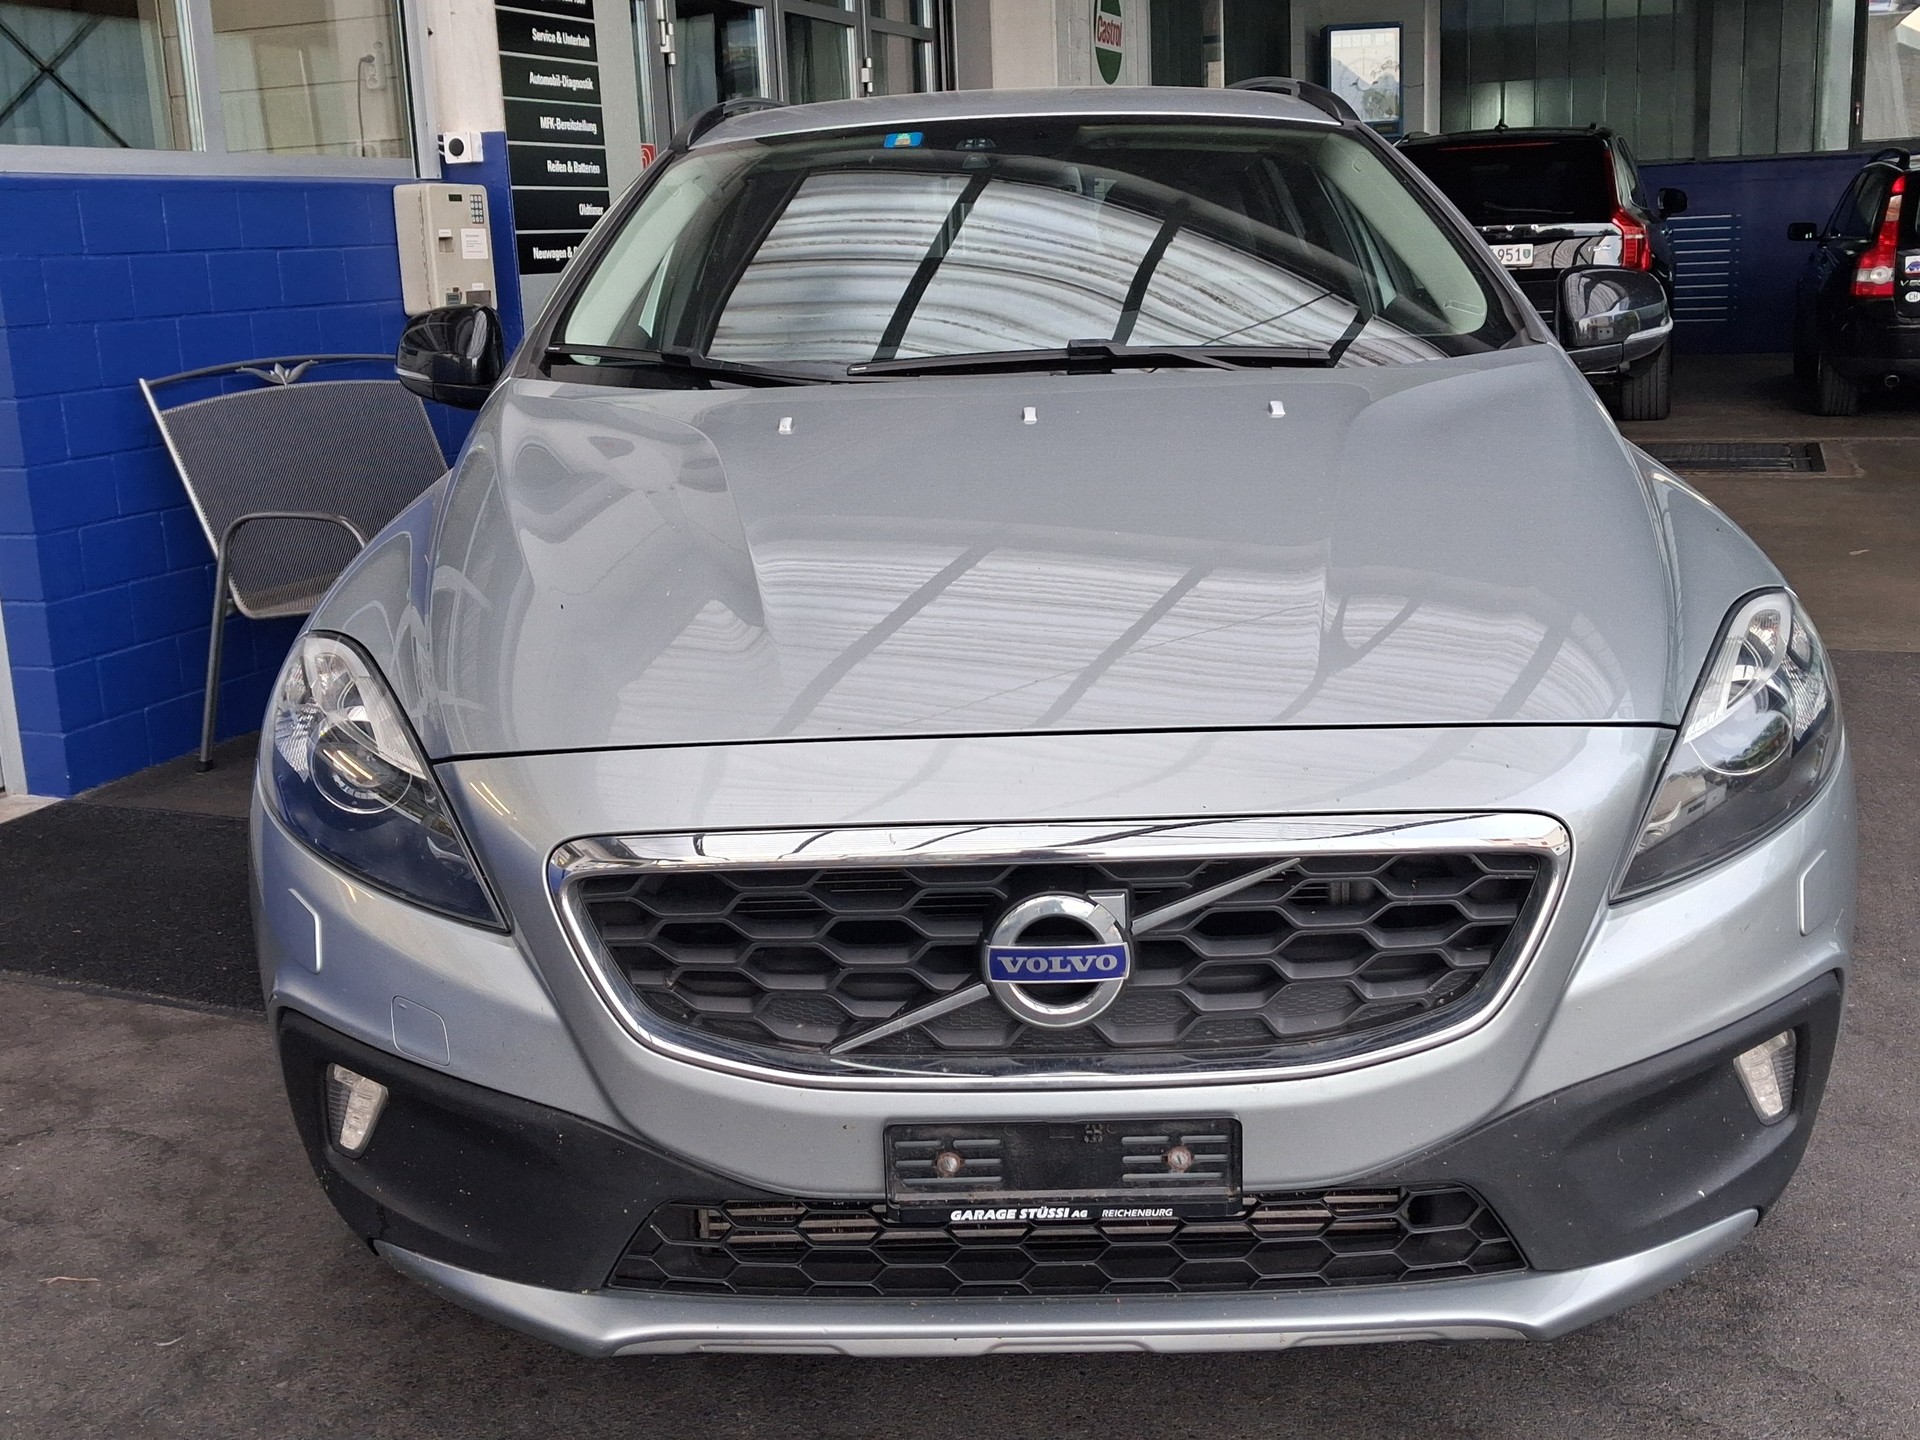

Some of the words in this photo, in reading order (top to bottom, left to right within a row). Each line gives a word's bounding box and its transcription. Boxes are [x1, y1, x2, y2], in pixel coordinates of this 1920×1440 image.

[532, 27, 556, 43] Service
[556, 31, 562, 44] &
[562, 32, 590, 48] Unterhalt
[1097, 15, 1123, 47] Castrol
[529, 71, 594, 91] Automobil-Diagnostik
[540, 116, 598, 135] MFK-Bereitstellung
[547, 160, 567, 173] Reifen
[567, 160, 573, 173] &
[573, 161, 600, 174] Batterien
[578, 203, 604, 216] Oldtimer
[533, 247, 567, 261] Neuwagen
[567, 246, 573, 258] &
[997, 954, 1118, 973] VOLVO
[950, 1208, 1017, 1221] GARAGE
[1019, 1206, 1070, 1220] STÜSSI
[1071, 1209, 1088, 1219] AG
[1101, 1207, 1174, 1219] REICHENBURG
